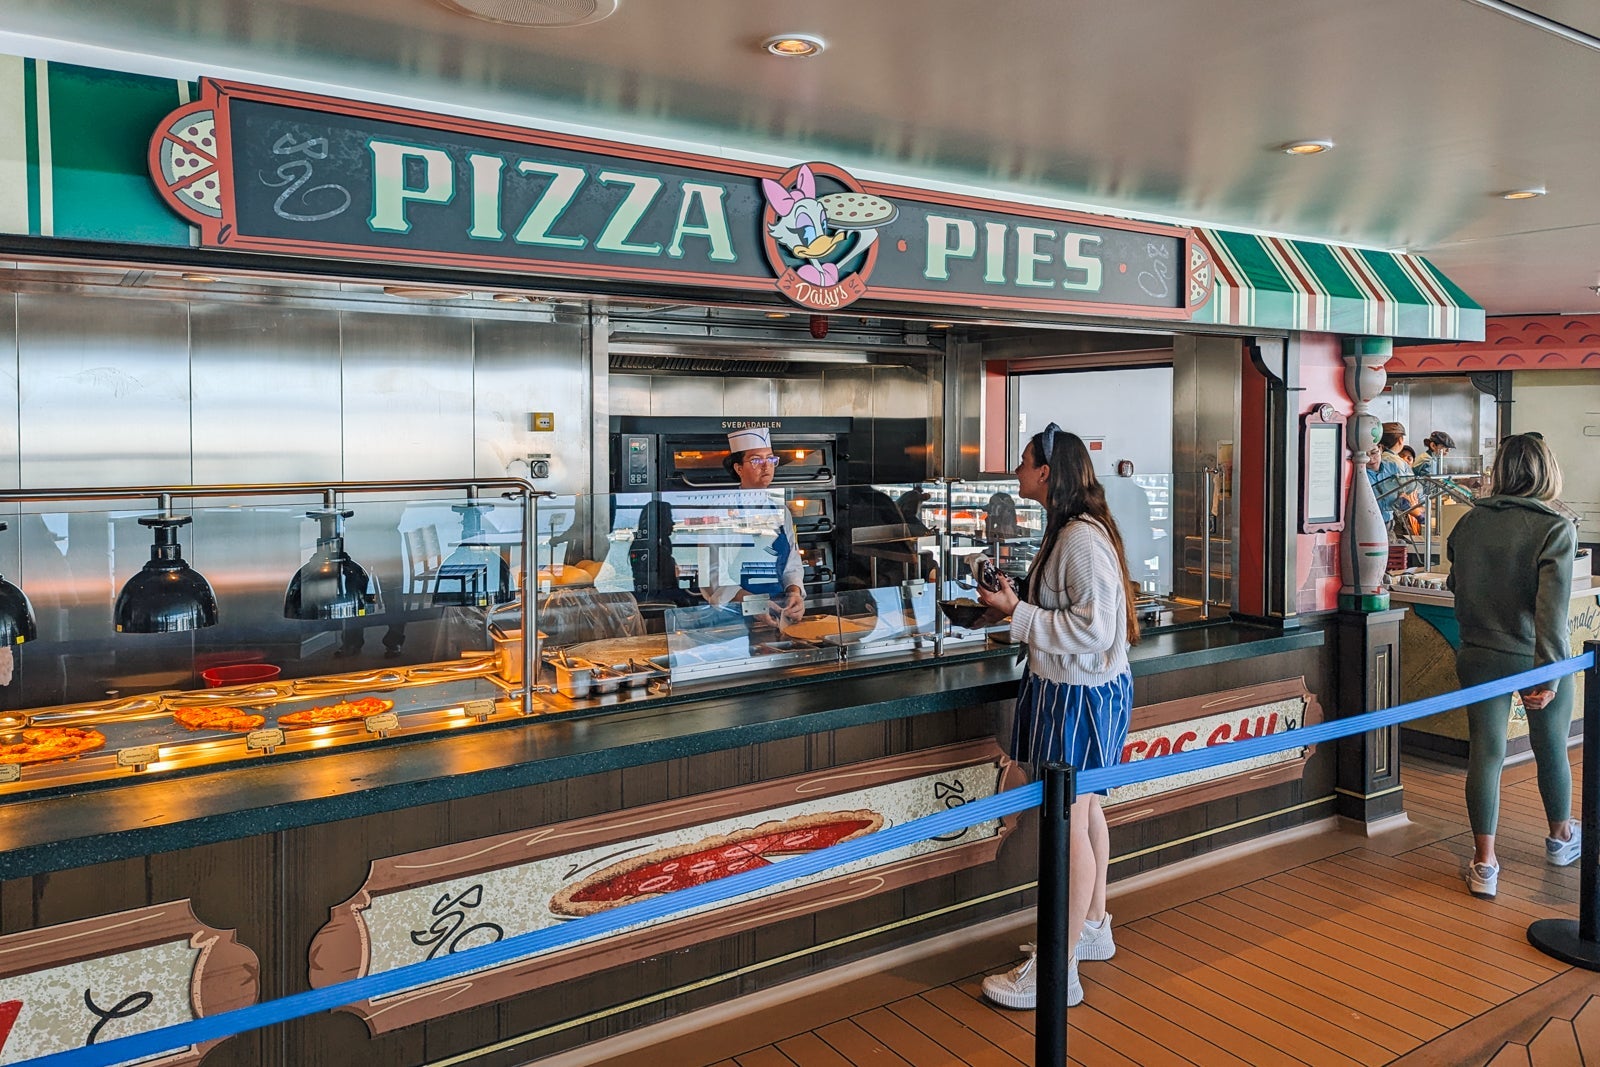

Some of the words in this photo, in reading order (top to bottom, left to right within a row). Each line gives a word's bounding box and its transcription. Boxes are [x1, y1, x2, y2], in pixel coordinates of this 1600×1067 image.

[366, 137, 737, 263] PIZZA
[923, 212, 1102, 294] PIES
[795, 282, 849, 307] Daisy's
